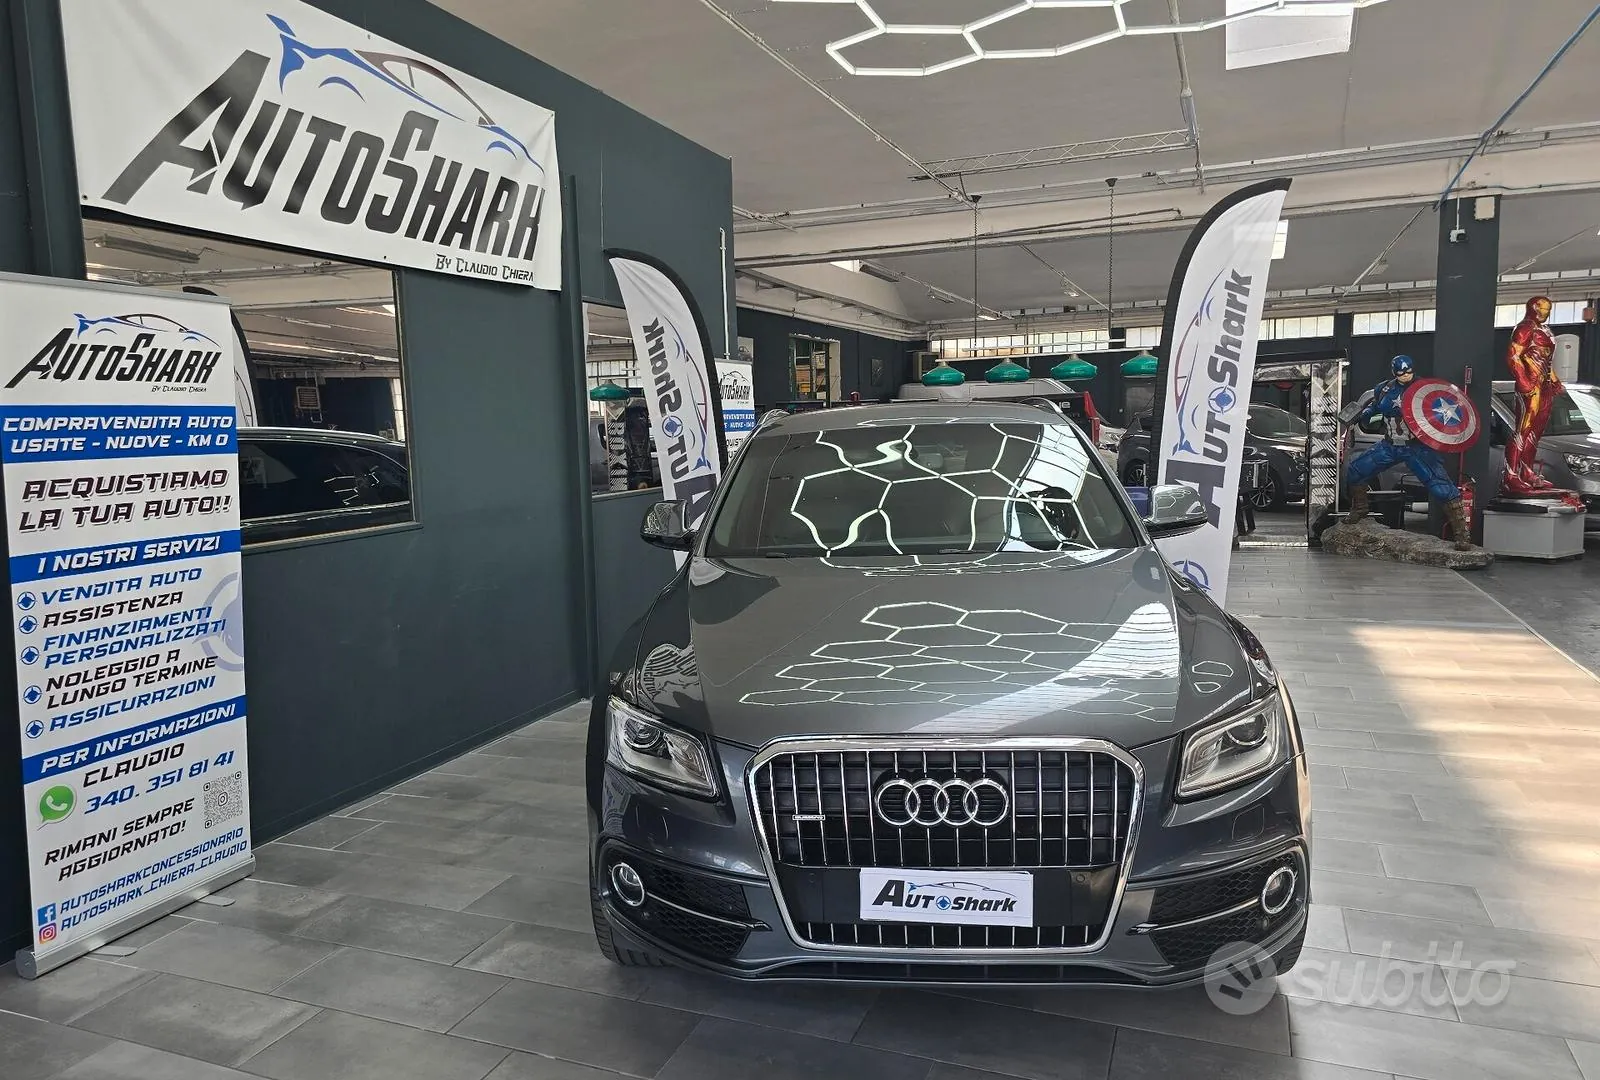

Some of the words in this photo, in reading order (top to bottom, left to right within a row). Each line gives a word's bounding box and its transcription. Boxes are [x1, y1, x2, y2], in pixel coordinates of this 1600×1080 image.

[456, 257, 499, 276] CLAUDIO
[502, 265, 534, 281] CHIERA
[3, 416, 181, 432] COMPRAVENDITA
[187, 415, 233, 429] AUTO
[11, 437, 86, 454] USATE
[105, 435, 171, 449] NUOVE
[187, 434, 212, 448] KM
[22, 469, 228, 500] ACQUISTIAMO
[18, 508, 64, 533] LA
[72, 503, 137, 526] TUA
[142, 495, 233, 520] AUTO!!
[37, 557, 46, 574] I
[53, 546, 137, 572] NOSTRI
[143, 536, 220, 560] SERVIZI
[41, 577, 142, 605] VENDITA
[149, 568, 202, 588] AUTO
[42, 591, 183, 628] ASSISTENZA
[43, 606, 213, 651] FINANZIAMENTI
[44, 619, 227, 669] PERSONALIZZATI
[46, 652, 160, 692] NOLEGGIO
[166, 649, 181, 663] A
[47, 678, 127, 709] LUNGO
[133, 656, 219, 688] TERMINE
[49, 676, 216, 732] ASSICURAZIONI
[41, 752, 88, 774] PER
[95, 703, 236, 757] INFORMAZIONI
[83, 742, 185, 788] CLAUDIO
[84, 785, 139, 814] 340.
[145, 768, 183, 793] 351
[188, 759, 208, 776] 81
[213, 751, 235, 767] 41
[44, 827, 117, 866] RIMANI
[122, 797, 195, 836] SEMPRE
[58, 820, 187, 881] AGGIORNATO!
[59, 827, 244, 914] AUTOSHARKCONCESSIONARIO
[60, 840, 248, 932] AUTOSHARK_CHIERA_CLAUDIO
